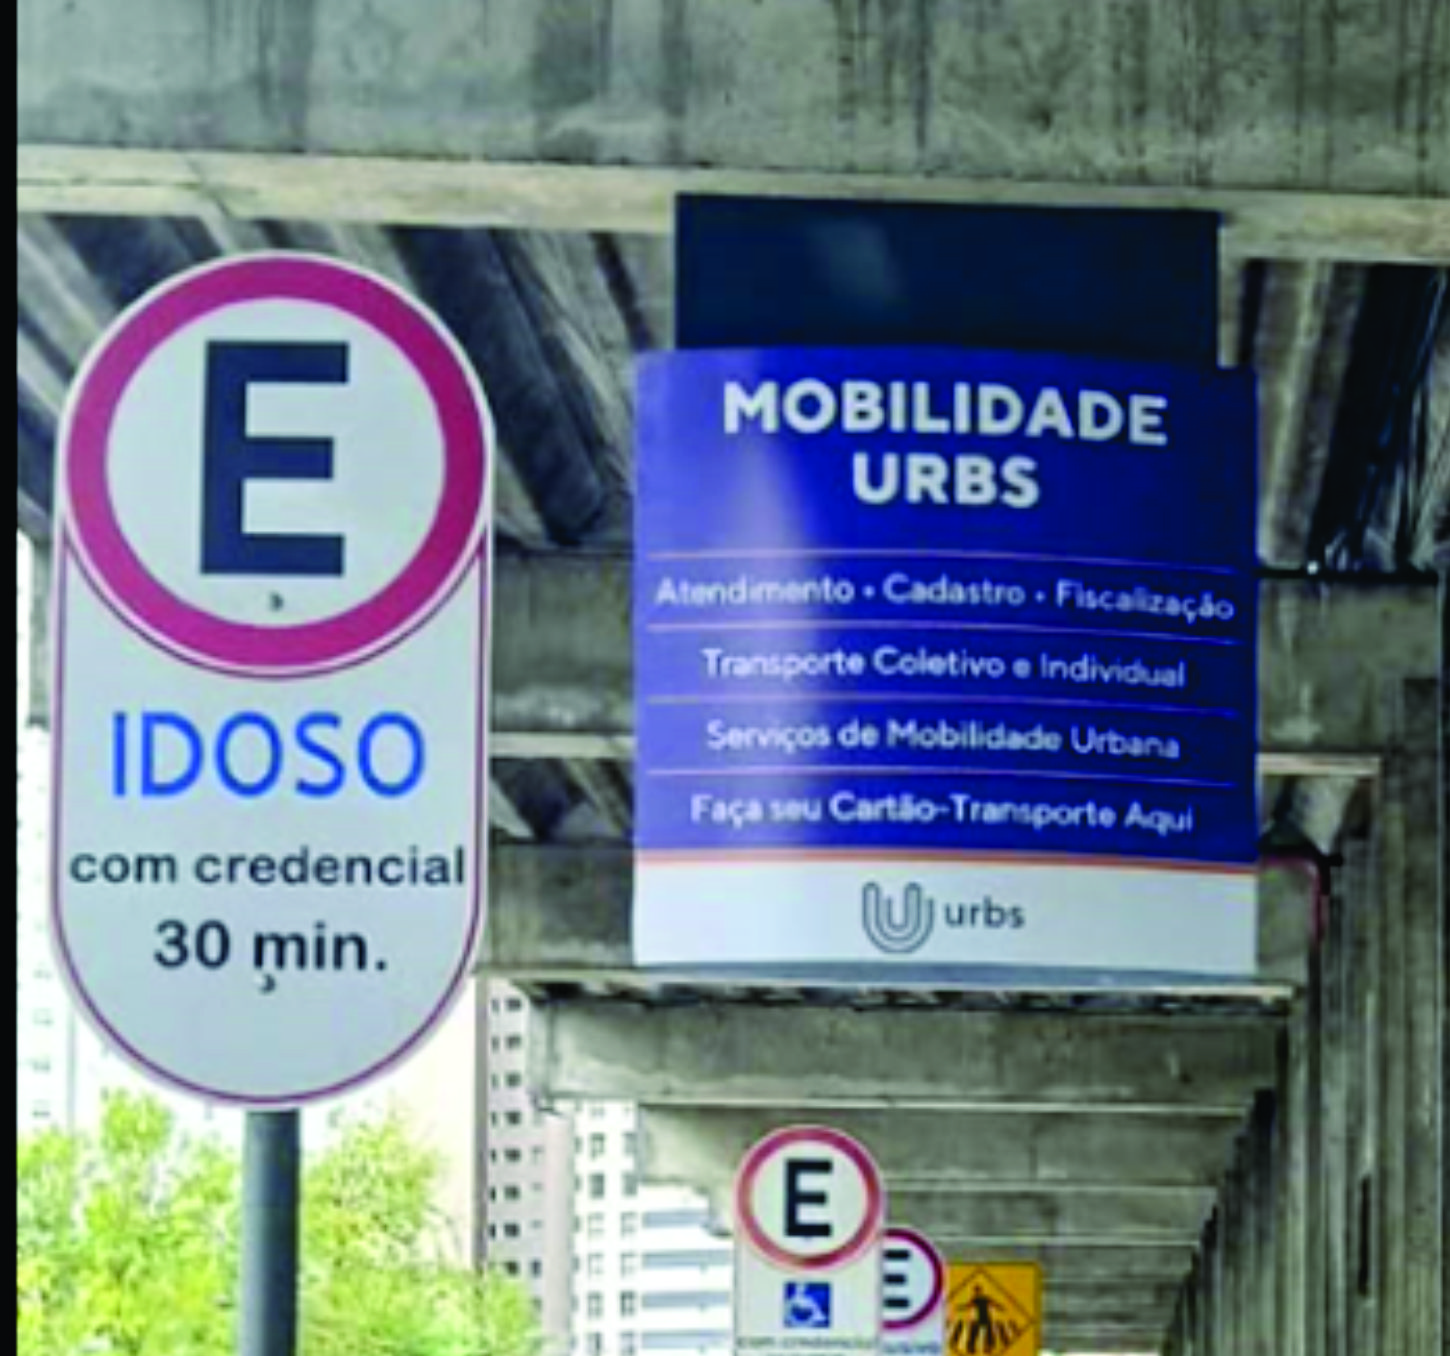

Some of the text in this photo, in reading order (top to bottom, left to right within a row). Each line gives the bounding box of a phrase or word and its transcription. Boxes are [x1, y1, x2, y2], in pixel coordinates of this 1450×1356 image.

[723, 378, 1168, 446] MOBILIDADE
[200, 340, 350, 578] E
[852, 451, 1040, 508] URBS
[655, 571, 1235, 625] Atendimento Cadastro Fiscalização
[701, 644, 1187, 688] Transporte Coletivo e Individual
[112, 710, 425, 798] IDOSO
[706, 717, 1181, 759] Serviços de Mobilidade Urbana
[690, 792, 763, 829] Faça
[770, 799, 822, 822] seu
[1124, 799, 1194, 837] Aqui
[70, 845, 465, 885] com credencial
[944, 897, 1025, 930] urbs
[152, 918, 388, 971] 30 min.
[784, 1158, 833, 1238] E
